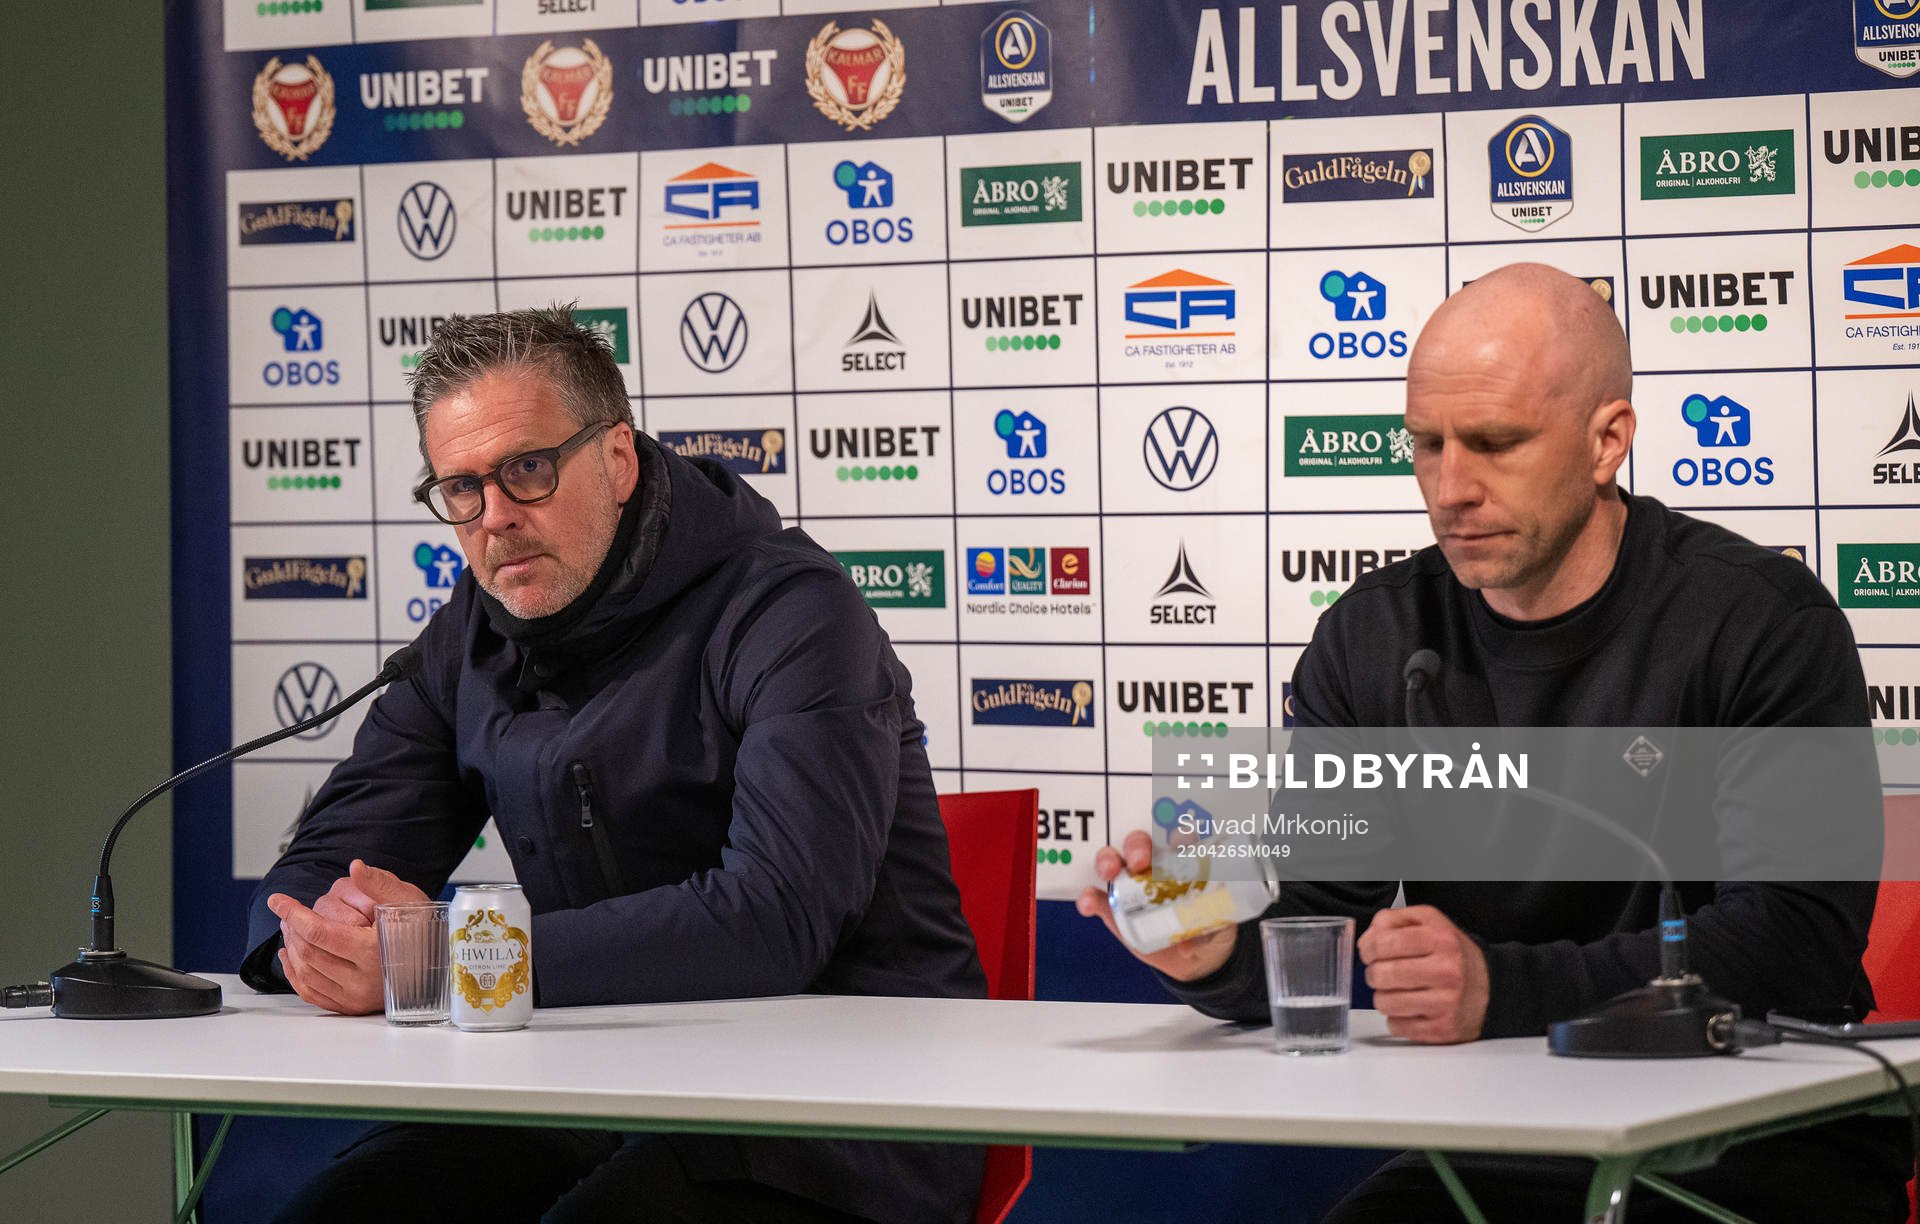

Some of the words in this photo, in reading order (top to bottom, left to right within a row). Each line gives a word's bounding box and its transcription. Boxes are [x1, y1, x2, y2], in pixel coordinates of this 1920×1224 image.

[1187, 0, 1705, 105] ALLSVENSKAN
[643, 50, 778, 93] UNIBET
[988, 71, 1045, 88] ALLSVENSKAN
[360, 68, 489, 109] UNIBET
[1000, 97, 1033, 108] UNIBET
[1823, 126, 1920, 164] UNIB
[1285, 156, 1408, 189] GuldFågeln
[1656, 148, 1740, 175] ÅBRO
[1107, 158, 1253, 194] UNIBET
[1497, 180, 1566, 197] ALLSVENSKAN
[1656, 179, 1690, 188] ORIGINAL
[1696, 176, 1740, 186] ALKOHOLFRI
[506, 187, 627, 221] UNIBET
[973, 179, 1039, 204] ÅBRO
[1511, 206, 1552, 218] UNIBET
[826, 216, 913, 246] OBOS
[1640, 271, 1794, 309] UNIBET
[1843, 267, 1920, 309] C
[962, 294, 1083, 329] UNIBET
[1308, 330, 1408, 360] OBOS
[1845, 326, 1864, 338] CA
[1866, 325, 1920, 338] FASTIGH
[842, 351, 906, 371] SELECT
[1125, 345, 1140, 357] CA
[1143, 343, 1217, 355] FASTIGHETER
[1220, 343, 1236, 354] AB
[263, 360, 340, 387] OBOS
[242, 437, 361, 469] UNIBET
[664, 433, 762, 462] uldFågeln
[810, 426, 940, 459] UNIBET
[1299, 427, 1383, 454] ÅBRO
[1299, 457, 1333, 466] ORIGINAL
[1339, 456, 1383, 465] ALKOHOLFRI
[1672, 457, 1774, 486] OBOS
[987, 468, 1066, 495] OBOS
[841, 562, 904, 588] BRO
[1282, 549, 1421, 582] UNIB
[1853, 557, 1920, 583] ÅBR
[1011, 580, 1043, 592] QUALITY
[1853, 588, 1890, 597] ORIGINAL
[966, 601, 1006, 614] Nordic
[1009, 601, 1048, 614] Choice
[1050, 601, 1092, 614] Hotels
[1150, 605, 1216, 624] SELECT
[973, 683, 1072, 714] GuldFågeln
[1117, 681, 1254, 713] UNIBET
[462, 948, 515, 961] HWILA
